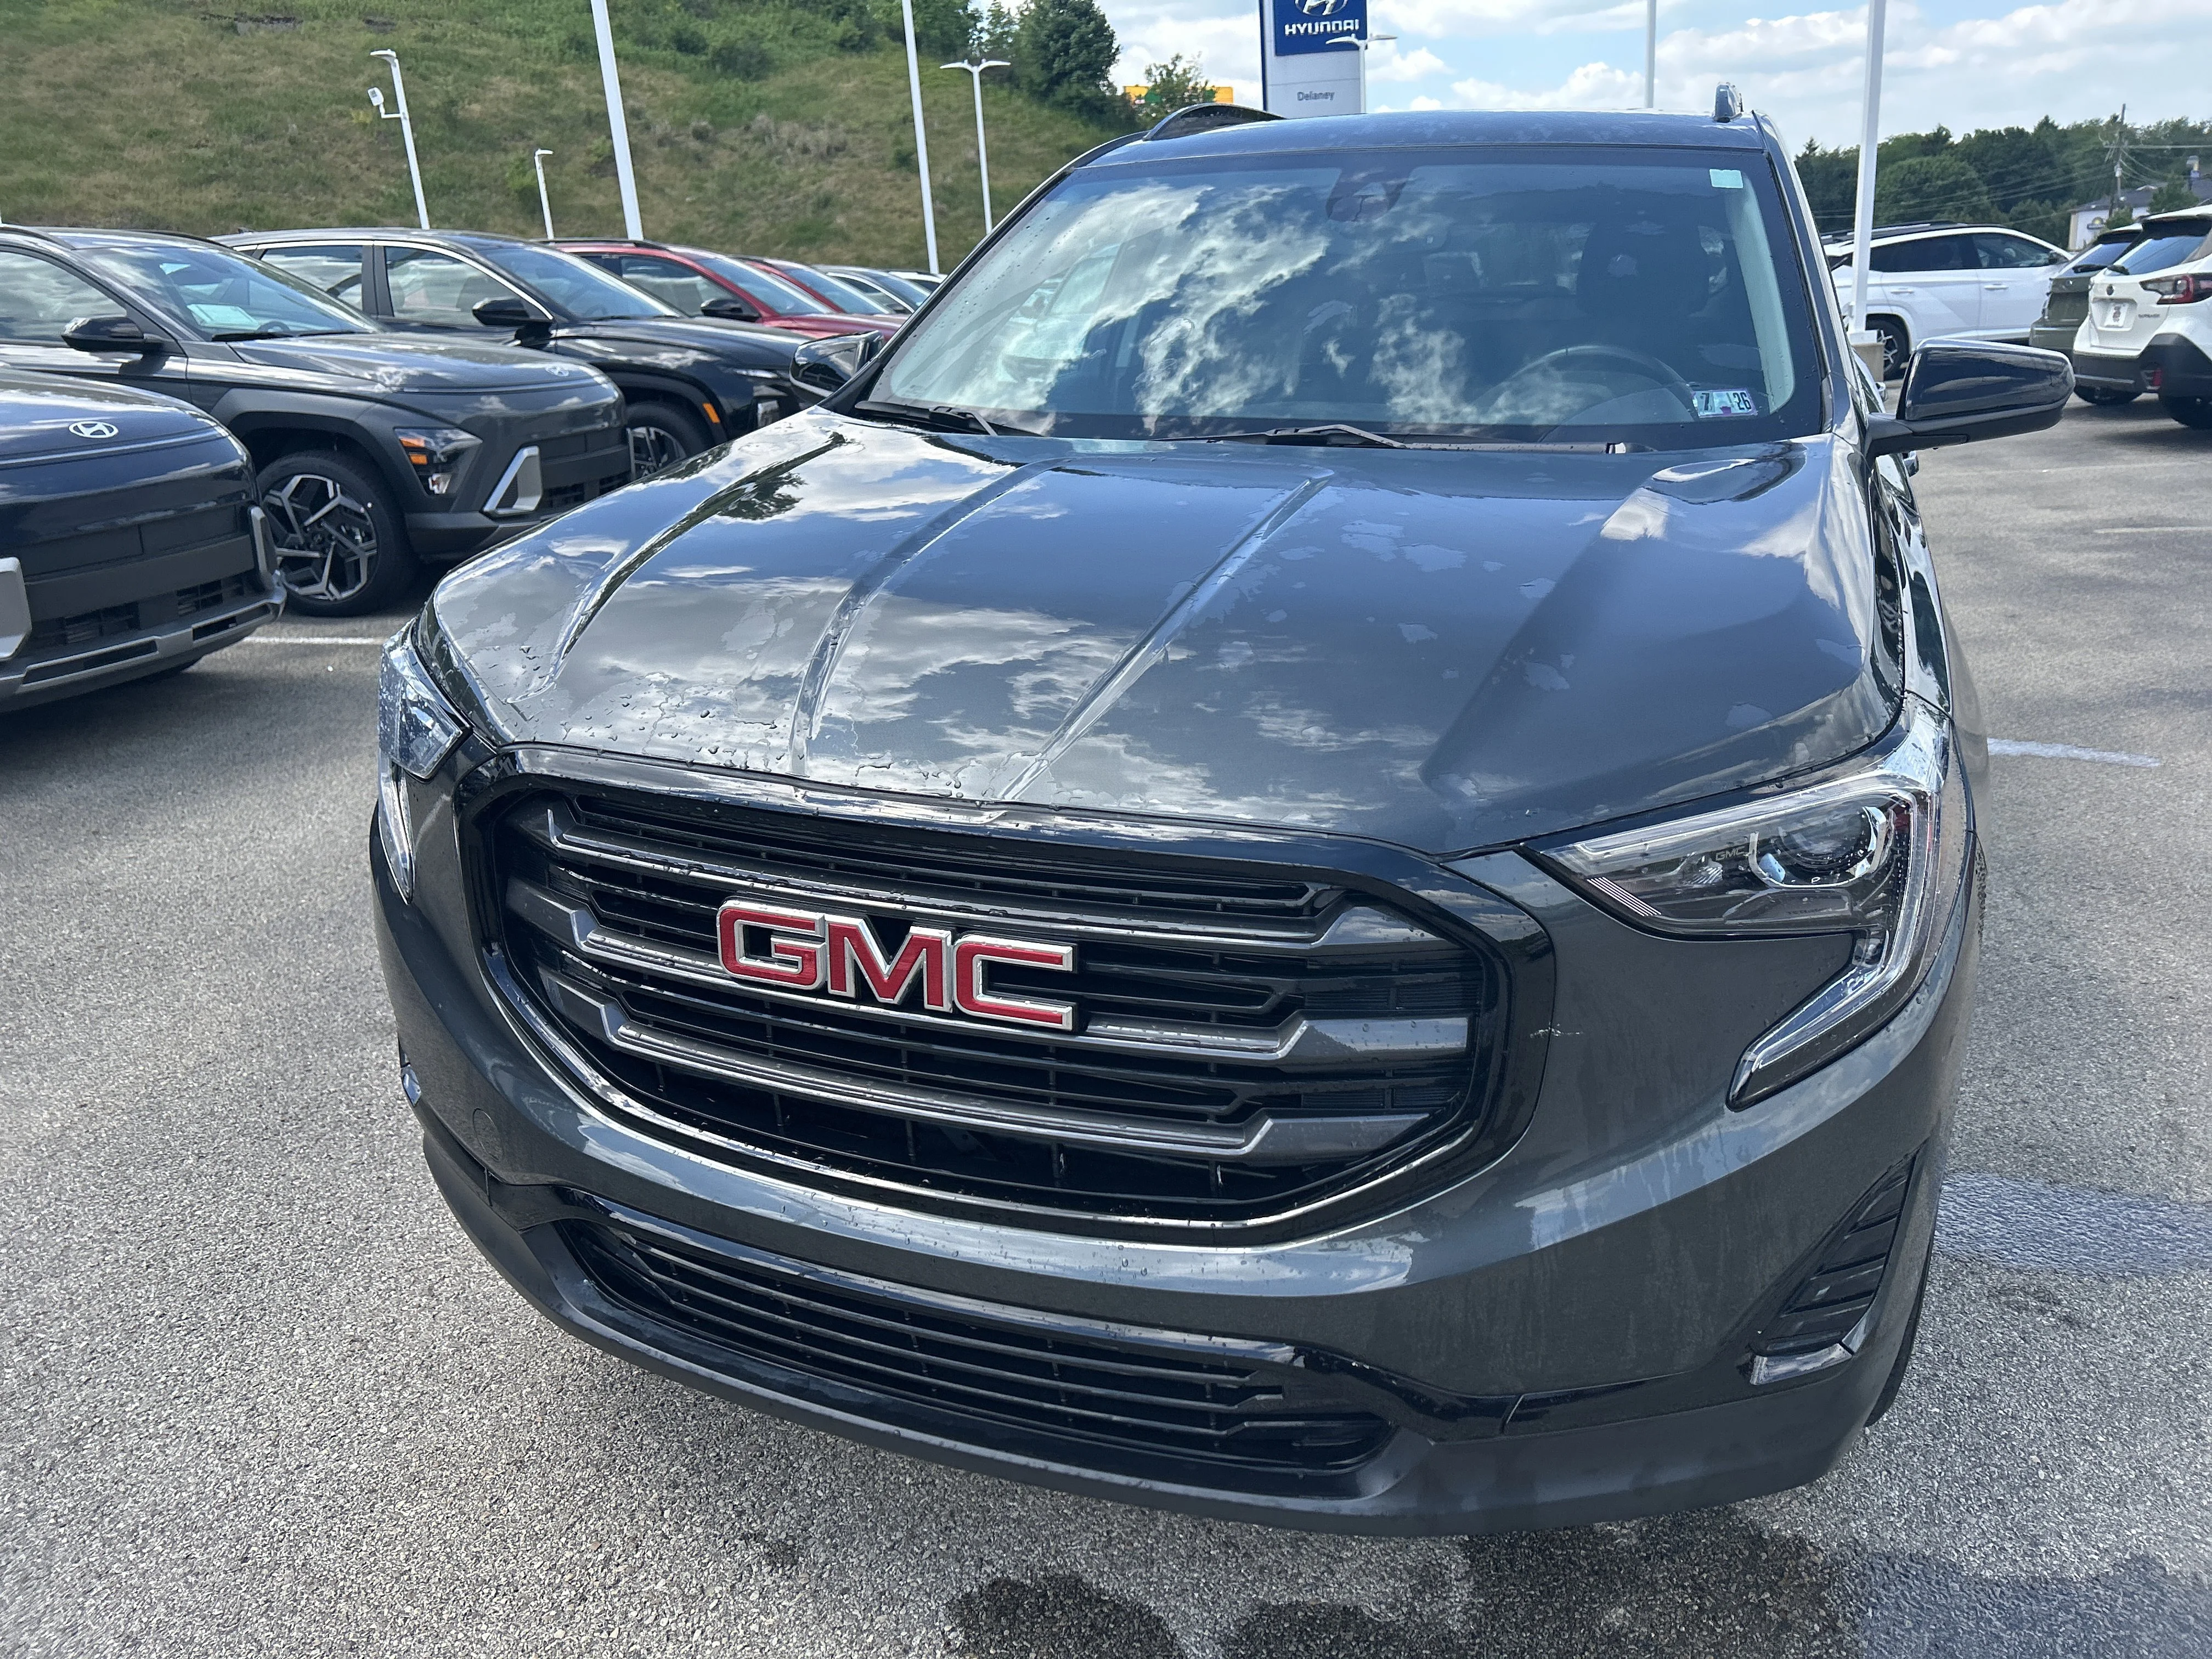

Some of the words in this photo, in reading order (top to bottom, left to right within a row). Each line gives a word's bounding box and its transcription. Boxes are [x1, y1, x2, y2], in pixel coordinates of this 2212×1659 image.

[1284, 19, 1359, 36] HYUNDAI
[1297, 91, 1335, 101] Delaney
[1701, 392, 1709, 410] 7
[1733, 392, 1752, 410] 26
[1716, 845, 1747, 861] GMC
[716, 899, 1074, 1031] GMC
